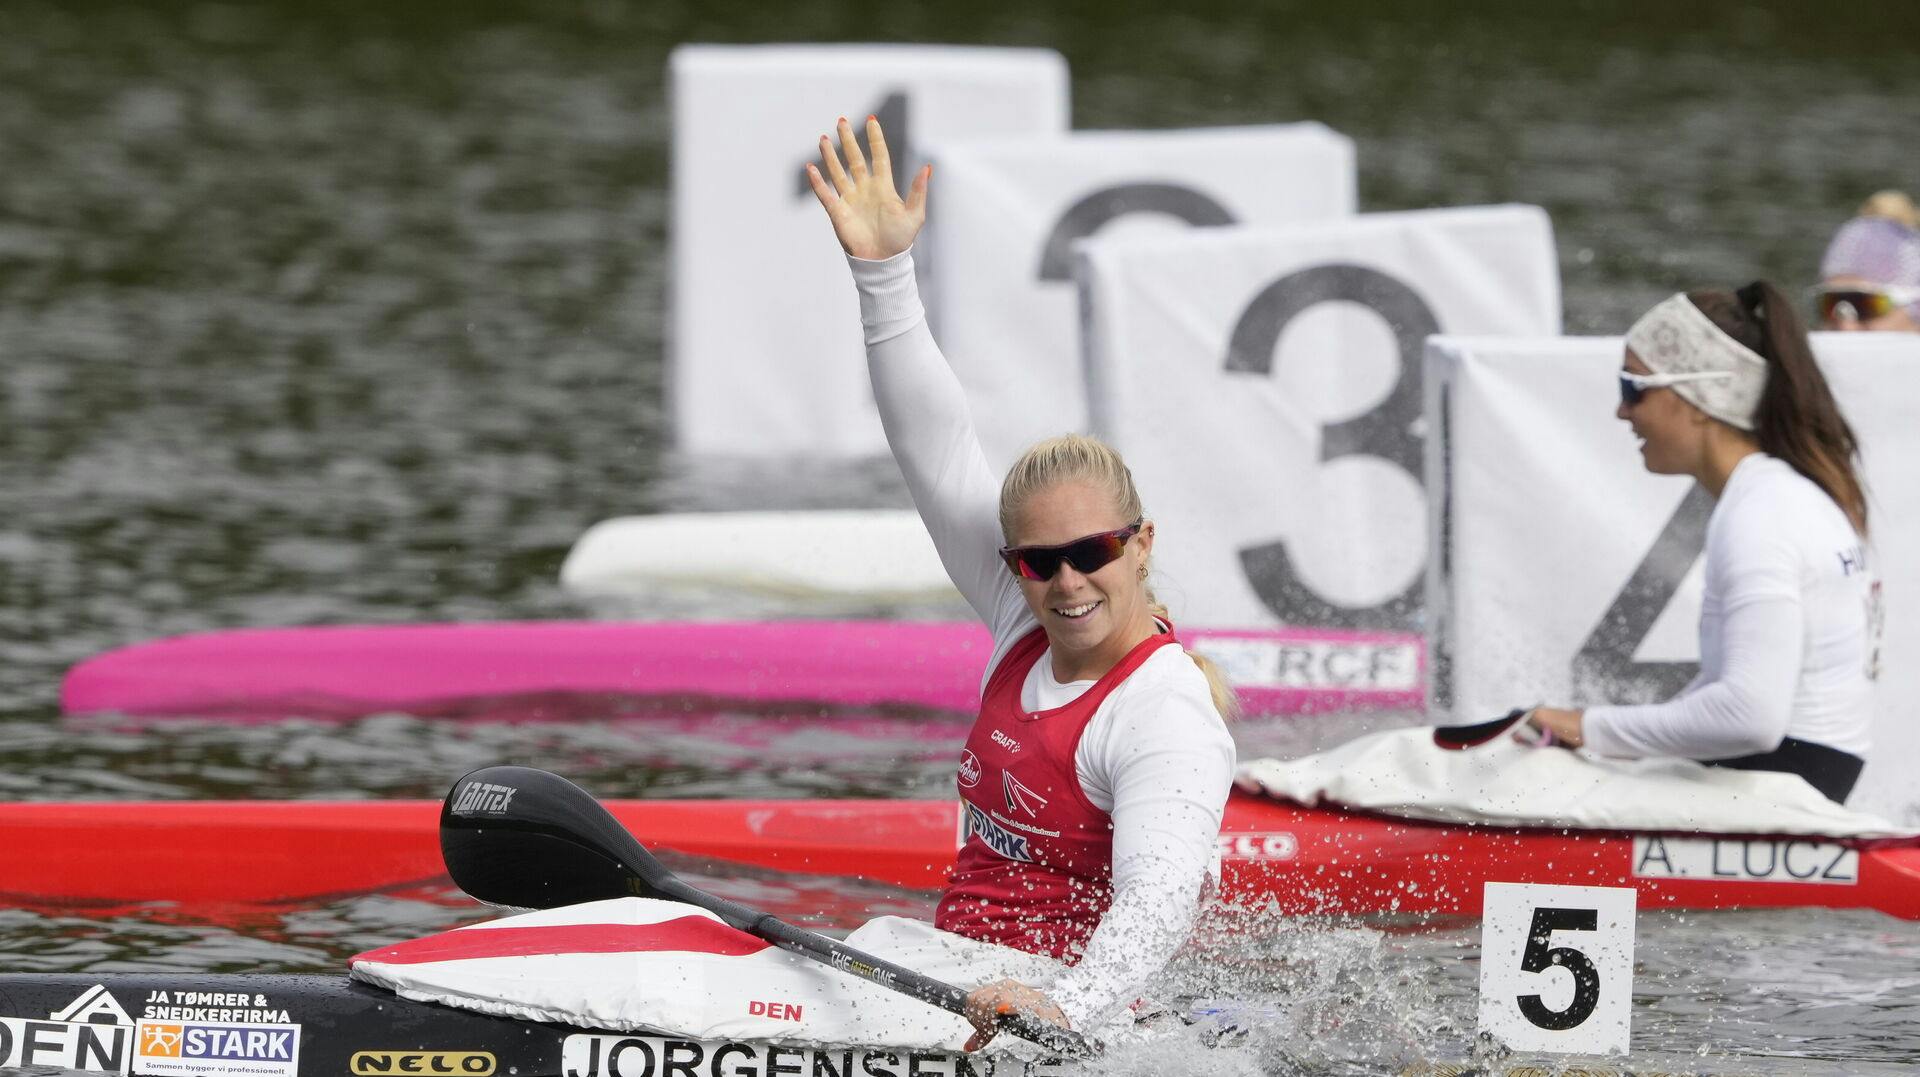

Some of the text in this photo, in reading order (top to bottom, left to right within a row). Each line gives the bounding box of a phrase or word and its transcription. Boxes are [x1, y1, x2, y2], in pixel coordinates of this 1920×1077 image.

[1225, 263, 1440, 630] 3
[991, 729, 1016, 751] CRAFT
[968, 803, 1030, 860] STARK
[1218, 832, 1296, 857] ELO
[1712, 840, 1853, 880] LUCZ
[1517, 907, 1600, 1030] 5
[145, 990, 268, 1007] JA TØMRER &
[144, 1005, 291, 1024] SNEDKERFIRMA
[748, 1001, 803, 1022] DEN
[185, 1028, 290, 1059] STARK
[146, 1062, 183, 1071] Sammen
[186, 1063, 216, 1073] bygger
[357, 1055, 491, 1073] NELO
[567, 1037, 995, 1077] JORGENSEN
